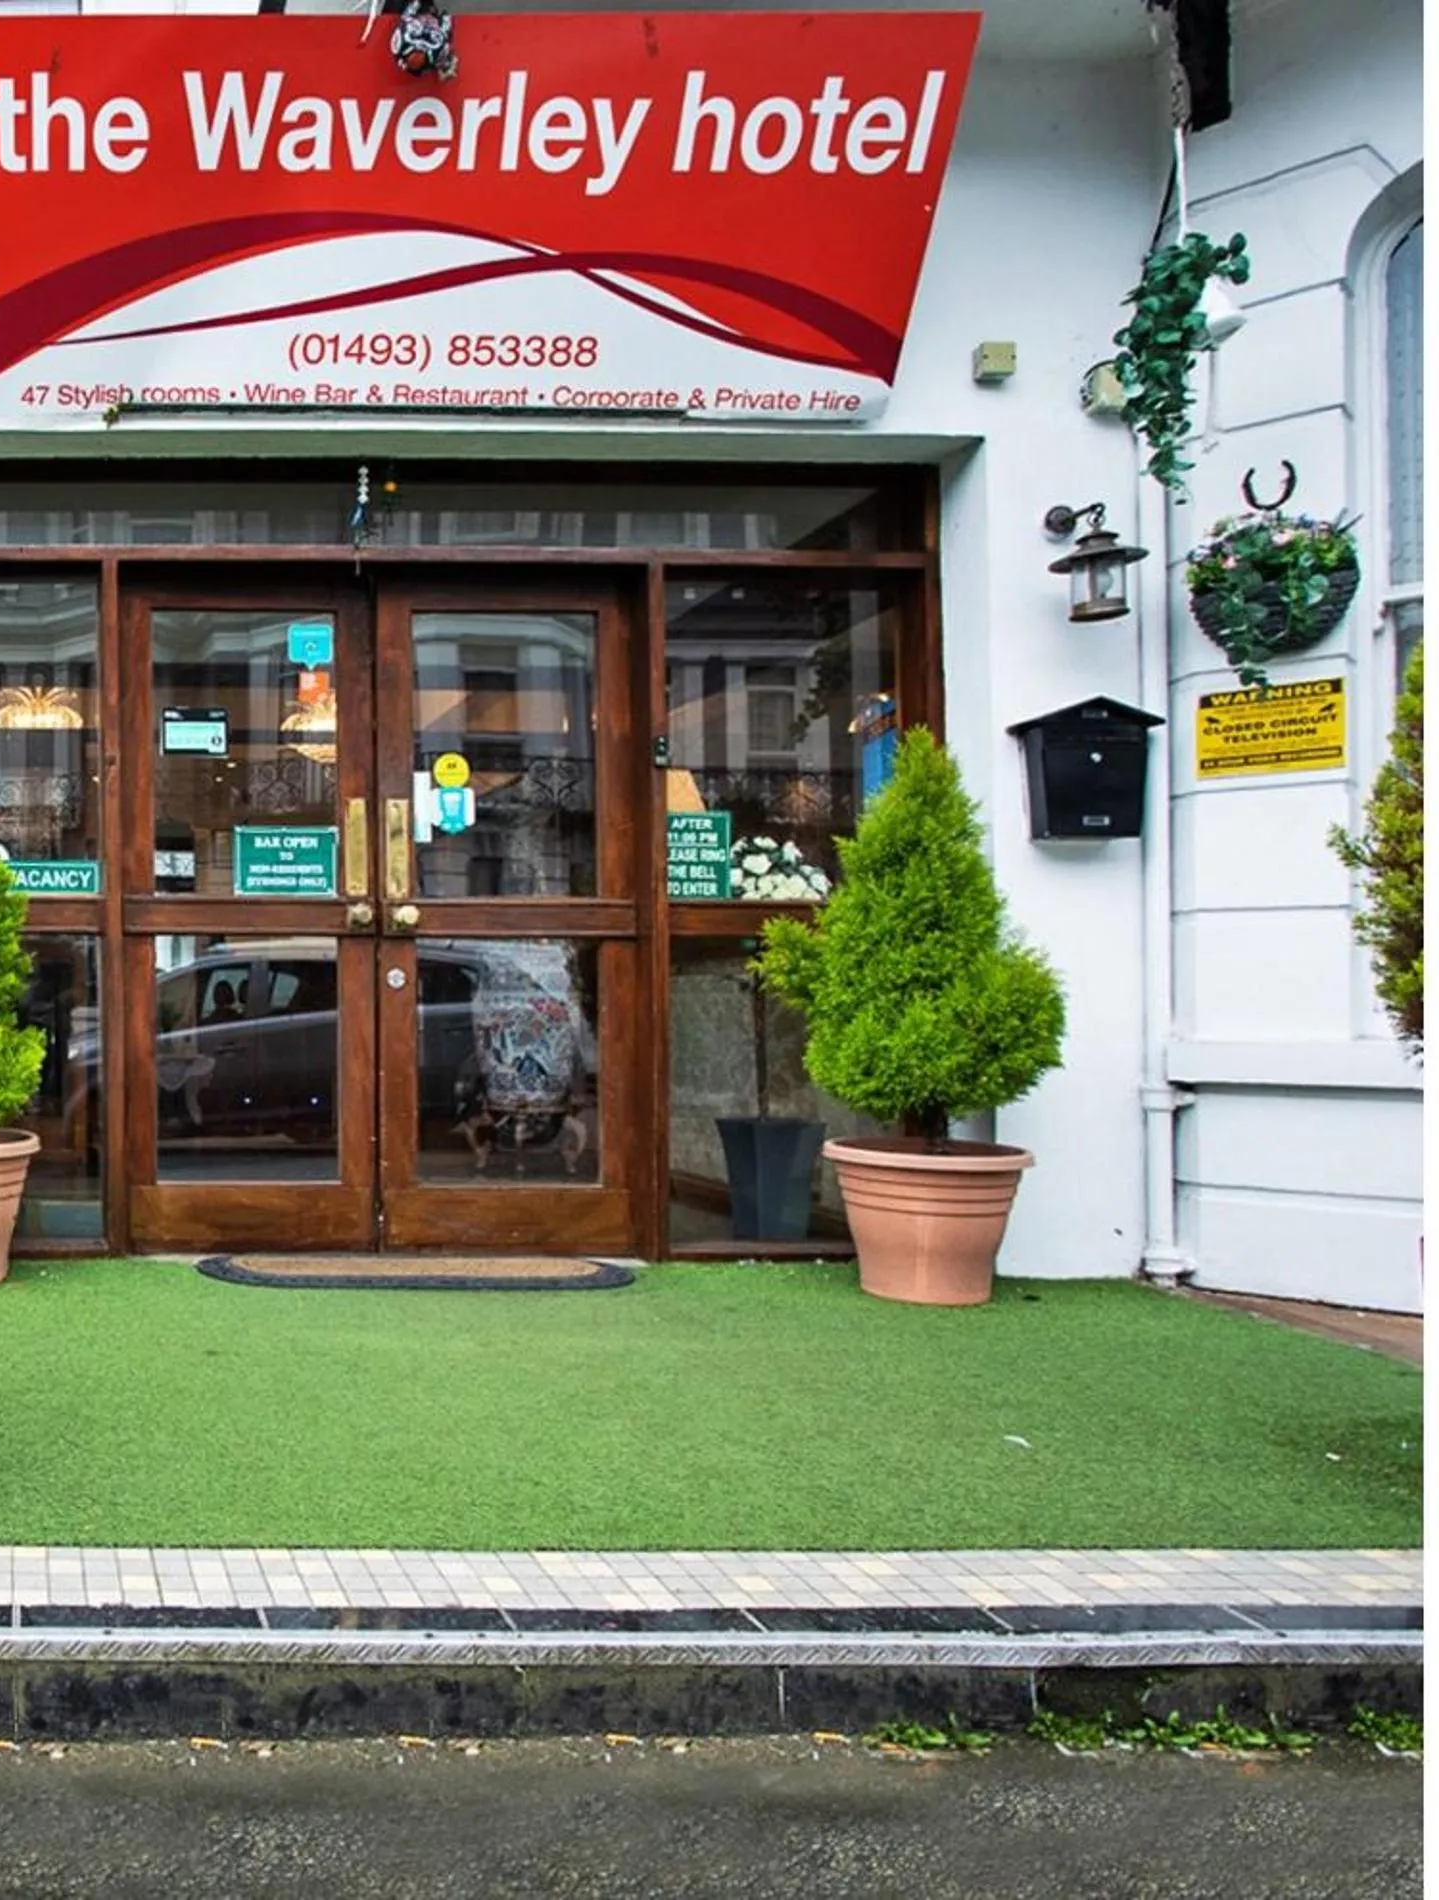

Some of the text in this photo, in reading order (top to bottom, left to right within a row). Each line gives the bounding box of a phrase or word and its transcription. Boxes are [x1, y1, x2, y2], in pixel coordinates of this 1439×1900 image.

[182, 71, 651, 196] Waverley
[671, 70, 947, 174] hotel
[287, 332, 599, 372] (01493) 853388
[20, 383, 862, 412] 47 Stylish rooms Wine Bar & Restaurant Corporate & Private Hire
[1202, 720, 1266, 736] CLOSED
[1269, 712, 1338, 729] CIRCUIT
[1222, 726, 1318, 744] TELEVISION
[670, 818, 713, 830] AFTER
[254, 836, 319, 849] BAR OPEN
[700, 849, 726, 862] RING
[690, 865, 717, 880] BELL
[682, 881, 718, 896] ENTER
